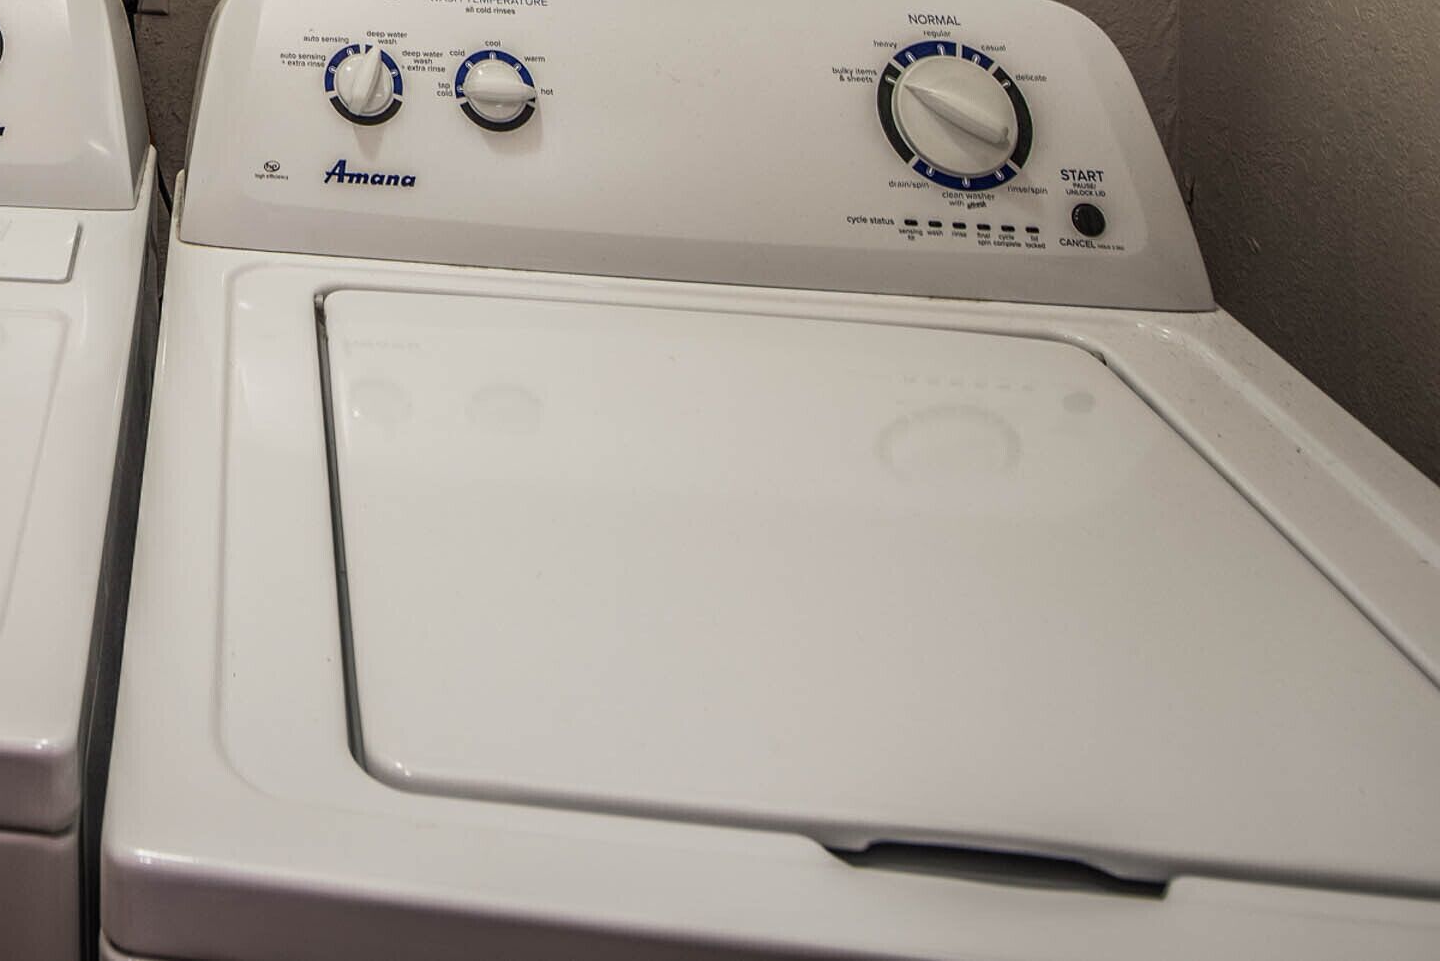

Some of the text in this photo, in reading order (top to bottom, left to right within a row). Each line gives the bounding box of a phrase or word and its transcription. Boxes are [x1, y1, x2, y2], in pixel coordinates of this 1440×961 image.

[908, 14, 961, 26] NORMAL
[366, 30, 386, 38] deep
[923, 30, 951, 38] regular
[321, 36, 350, 44] sensing
[298, 53, 326, 61] sensing
[402, 50, 421, 58] deep
[449, 49, 466, 57] cold
[413, 57, 433, 65] wash
[407, 64, 426, 72] extra
[427, 65, 446, 73] rinse
[832, 67, 853, 75] bulky
[847, 75, 873, 83] sheets
[436, 89, 453, 97] cold
[540, 87, 554, 95] hot
[324, 159, 416, 187] Amana
[1060, 169, 1104, 182] START
[942, 190, 995, 200] clean washer
[847, 216, 895, 225] cycle status
[899, 228, 923, 236] sensing
[1059, 238, 1096, 248] CANCEL
